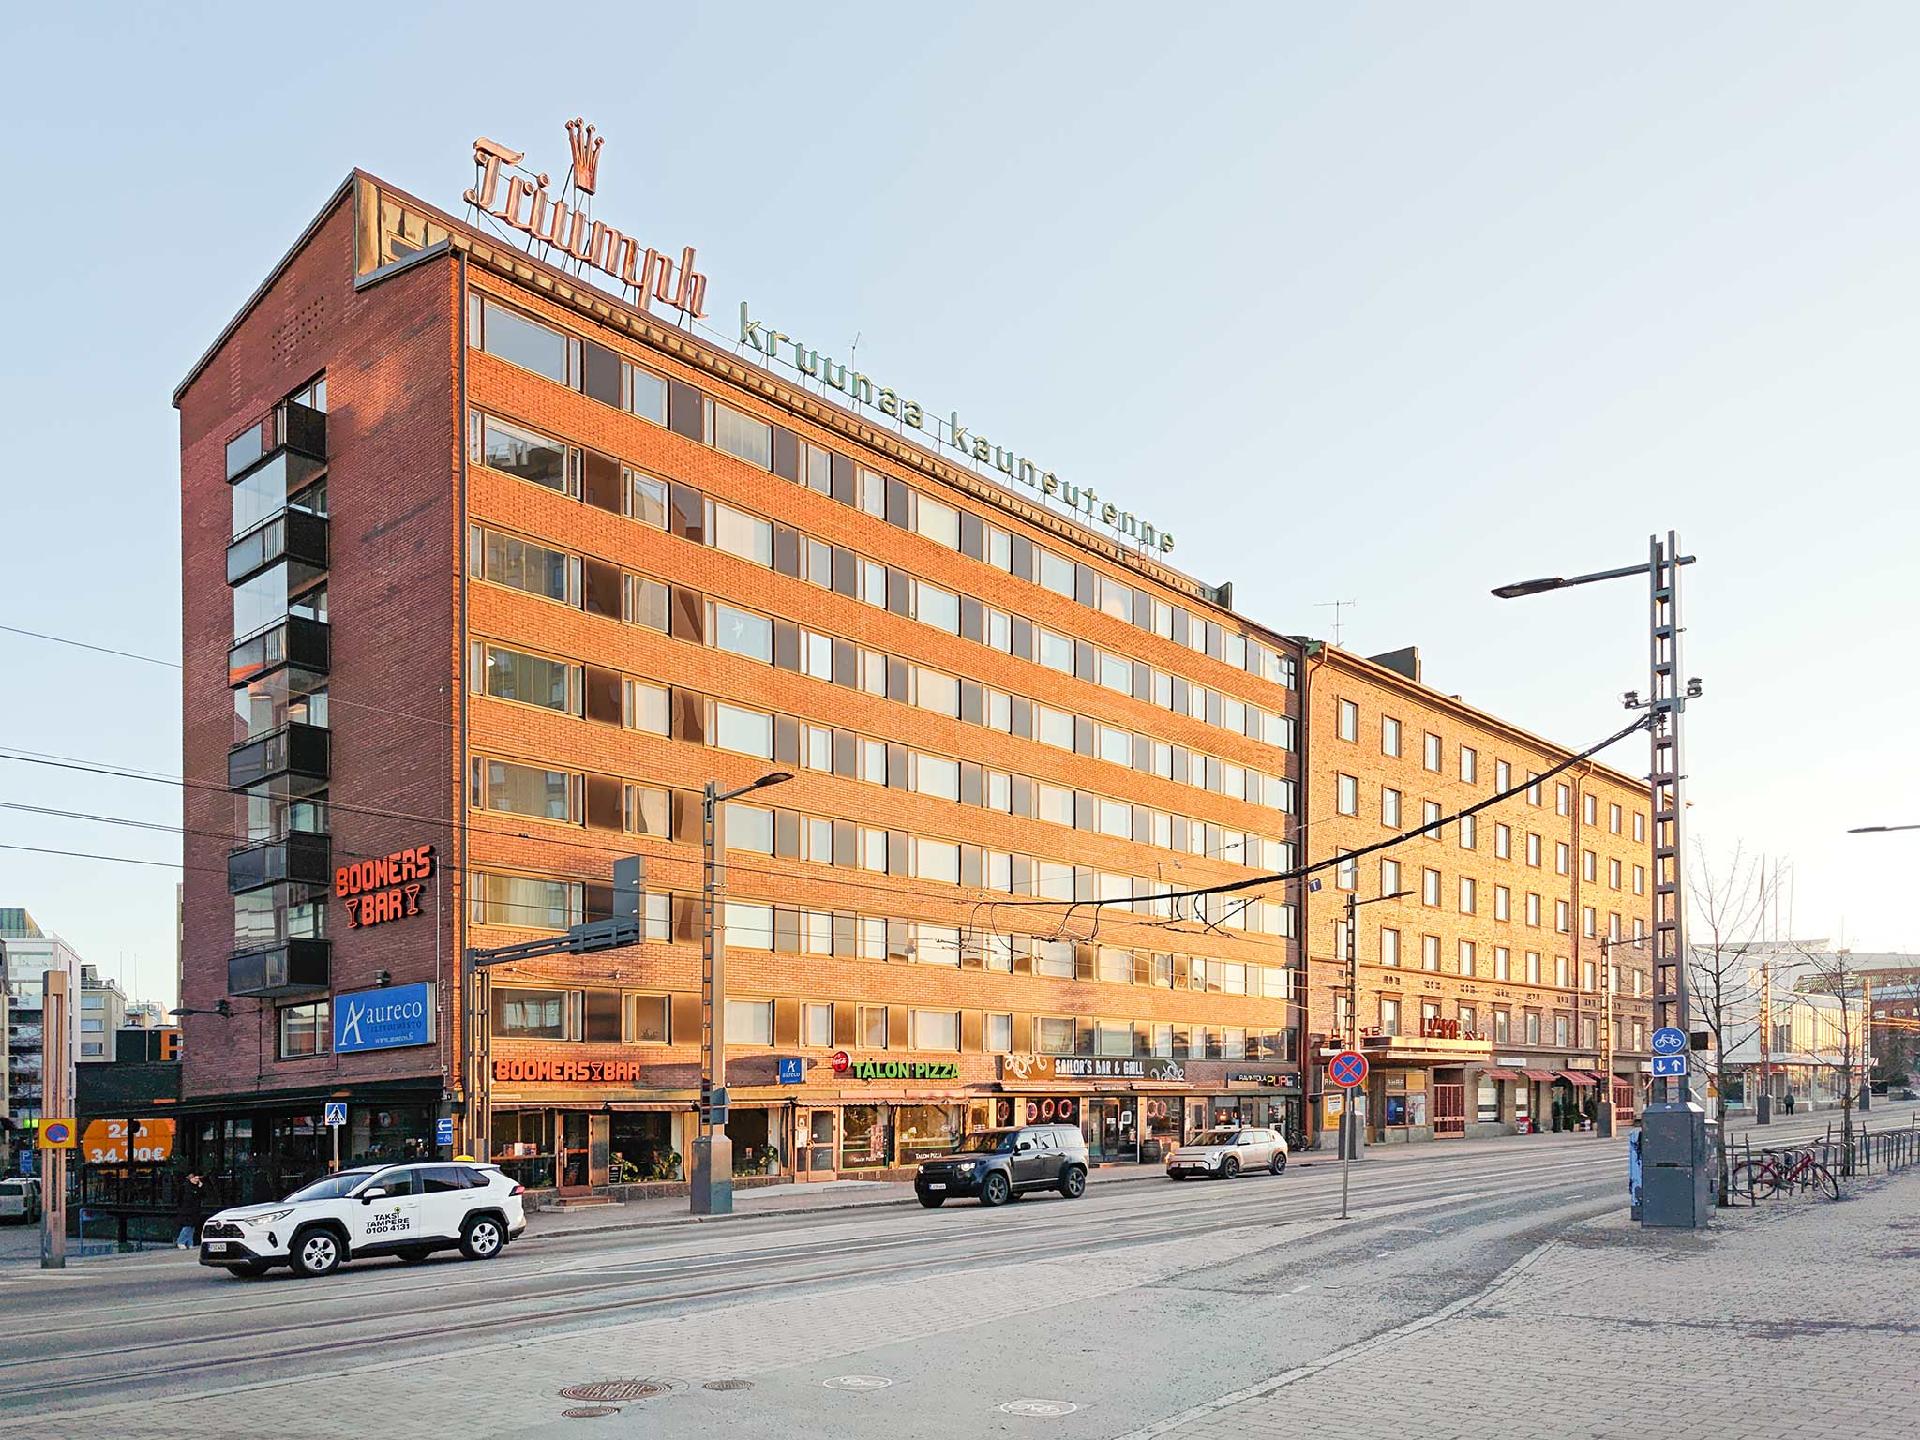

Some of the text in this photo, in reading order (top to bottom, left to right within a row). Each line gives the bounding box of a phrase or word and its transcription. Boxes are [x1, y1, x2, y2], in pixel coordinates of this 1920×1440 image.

[463, 136, 709, 319] Triumph
[740, 301, 1175, 553] kruunaa kauneutenne
[335, 844, 431, 898] BOOMERS
[361, 889, 403, 927] BAR
[366, 1001, 422, 1024] aureco
[495, 1059, 640, 1081] BOOMERS BAR
[853, 1061, 960, 1079] TALON PIZZA
[1055, 1058, 1145, 1075] SAILOR'S BAR & GRILL
[366, 1223, 410, 1234] 0100 4131
